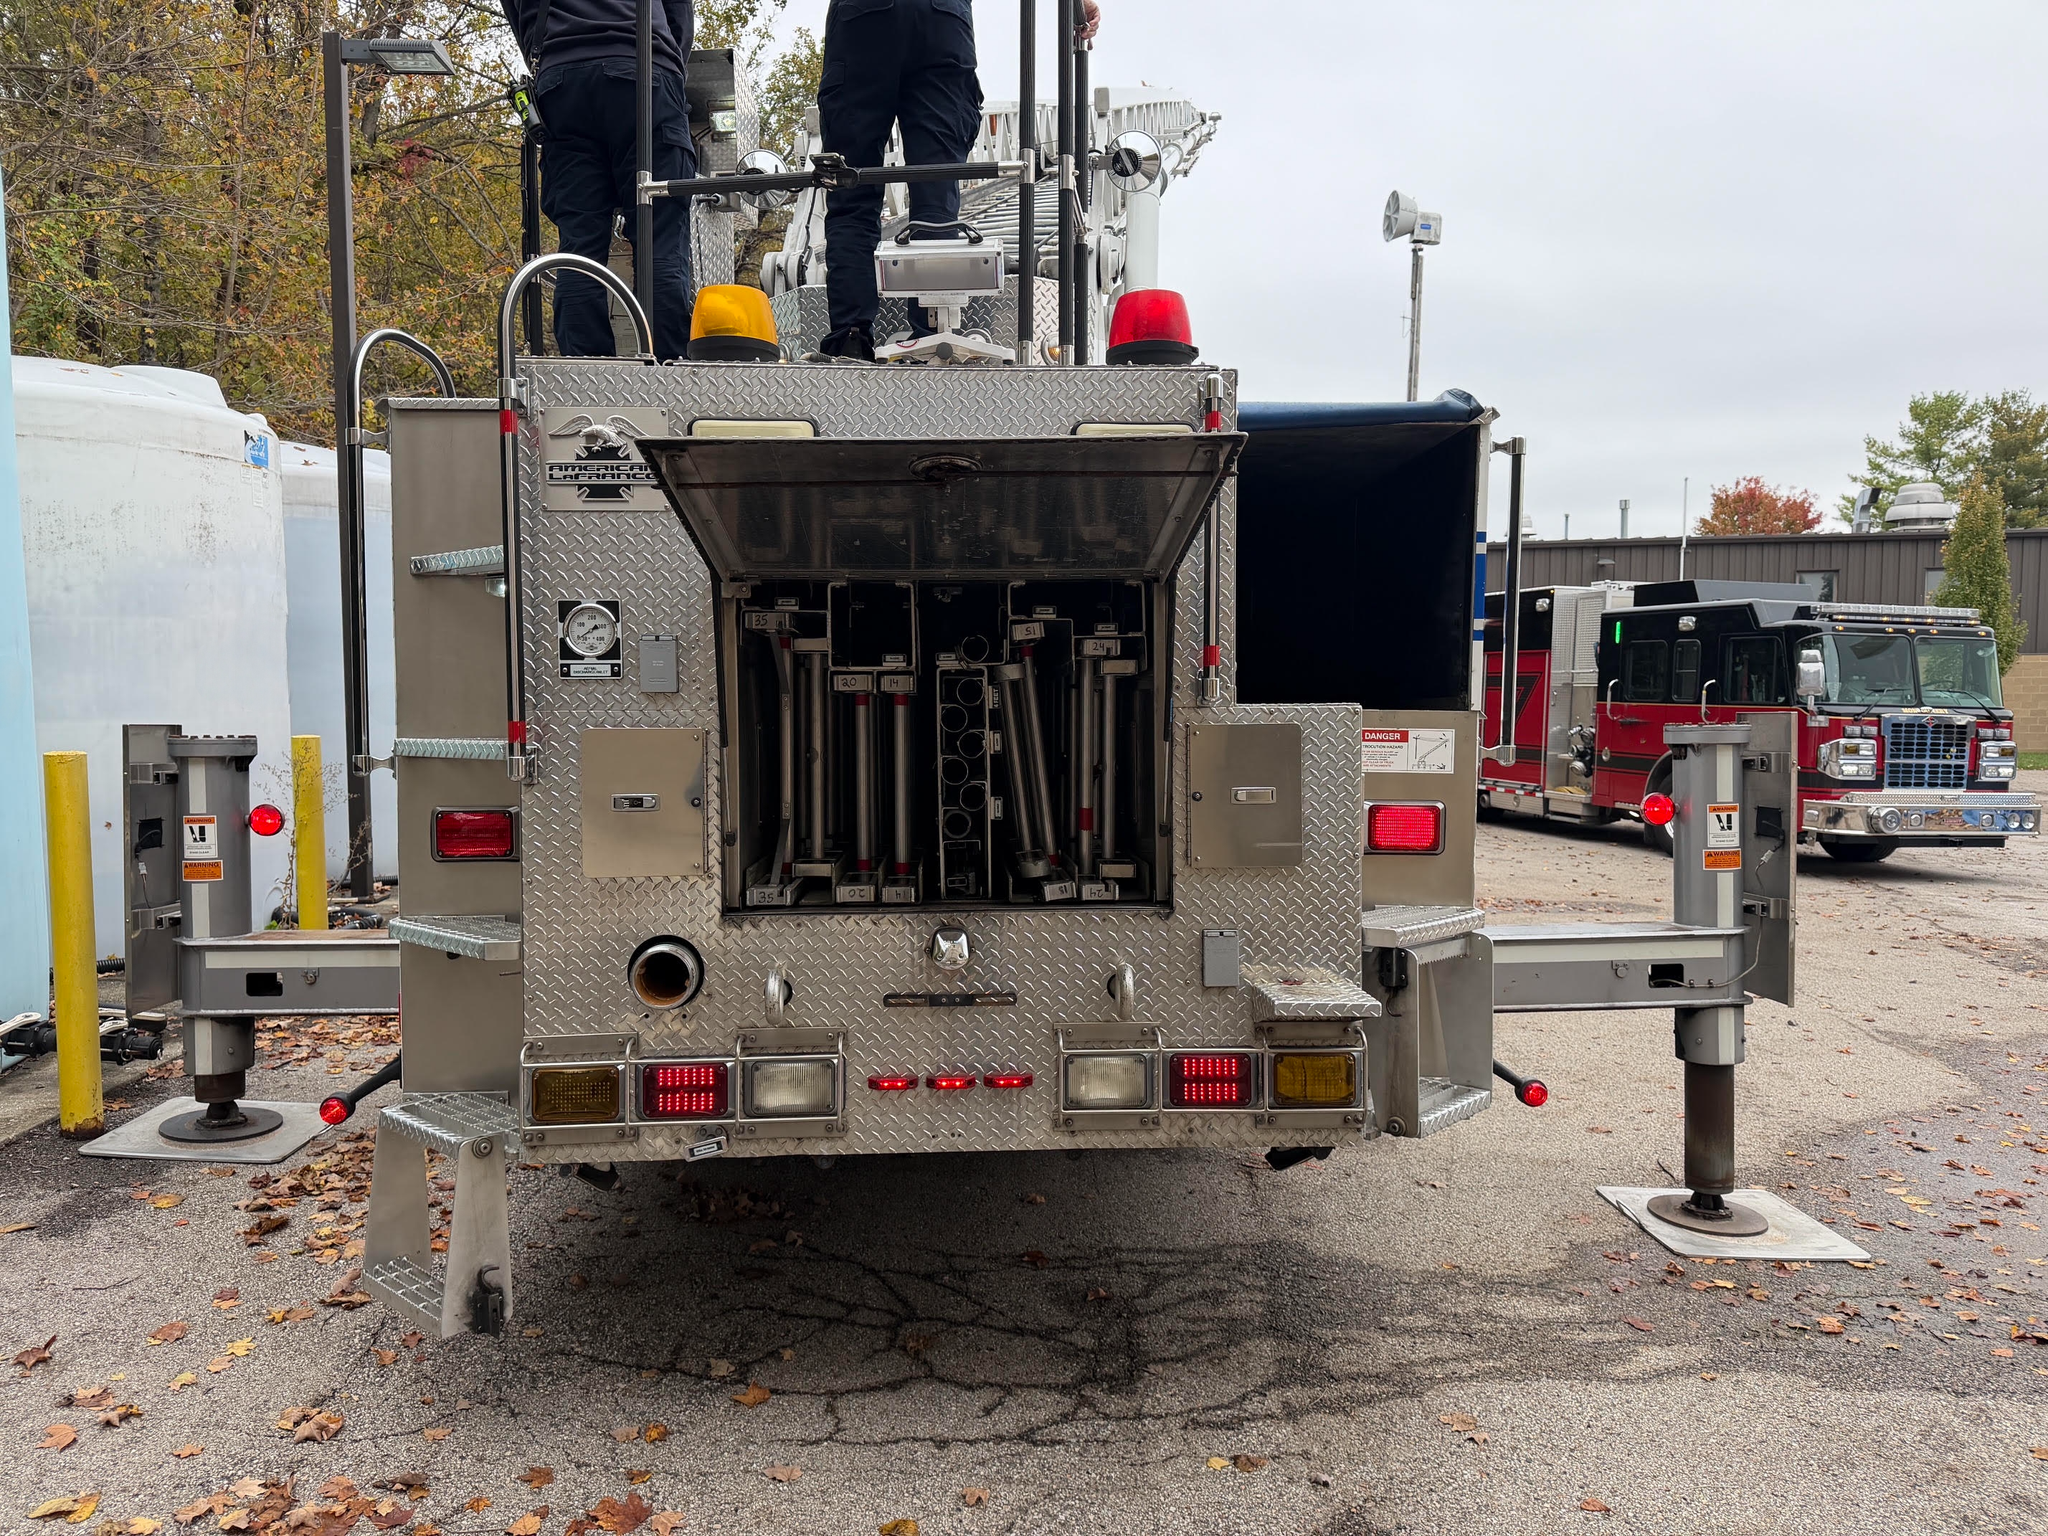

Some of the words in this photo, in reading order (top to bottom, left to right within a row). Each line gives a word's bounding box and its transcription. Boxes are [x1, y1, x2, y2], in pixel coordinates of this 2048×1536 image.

[754, 613, 768, 627] 35
[1092, 642, 1105, 652] 24
[841, 677, 857, 689] 20
[889, 677, 899, 688] 14
[1364, 732, 1401, 740] DANGER
[758, 891, 774, 903] 35
